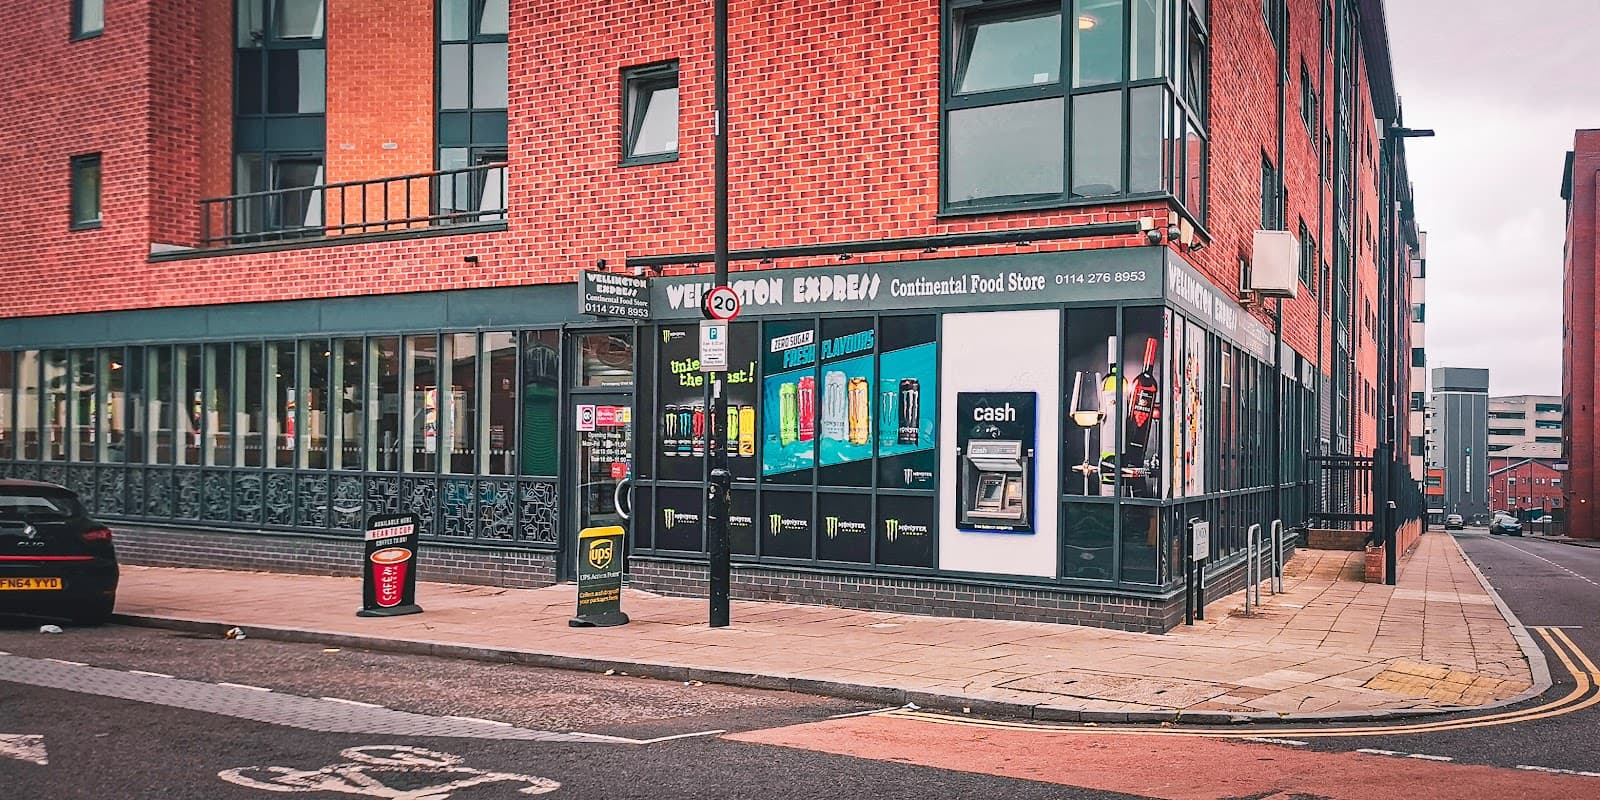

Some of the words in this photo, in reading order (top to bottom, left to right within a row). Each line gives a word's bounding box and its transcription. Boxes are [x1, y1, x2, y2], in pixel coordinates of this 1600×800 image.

[586, 273, 646, 288] WELLINGTON
[890, 274, 967, 297] Continental
[970, 272, 1004, 293] Food
[1008, 272, 1046, 292] Store
[1055, 273, 1084, 284] 0114
[1088, 272, 1111, 283] 276
[1115, 271, 1146, 282] 8953
[596, 284, 638, 297] EXPRESS
[793, 273, 880, 303] EXPRESS
[1169, 260, 1213, 319] WELLINGTON
[586, 294, 619, 303] Continental
[714, 296, 735, 311] 20
[586, 303, 606, 312] 0114
[609, 305, 625, 315] 276
[628, 308, 648, 317] 8953
[774, 339, 789, 350] ZERO
[789, 332, 810, 346] SUGAR
[783, 344, 816, 368] FRESH
[821, 329, 874, 360] FLAVOURS
[671, 358, 700, 373] Unle
[680, 373, 703, 387] the
[974, 402, 1016, 422] cash
[374, 519, 399, 528] AVAILABLE
[390, 527, 398, 536] TO
[399, 526, 411, 535] CUP
[591, 548, 610, 564] ups
[0, 579, 31, 588] FN64
[36, 579, 58, 588] YYD
